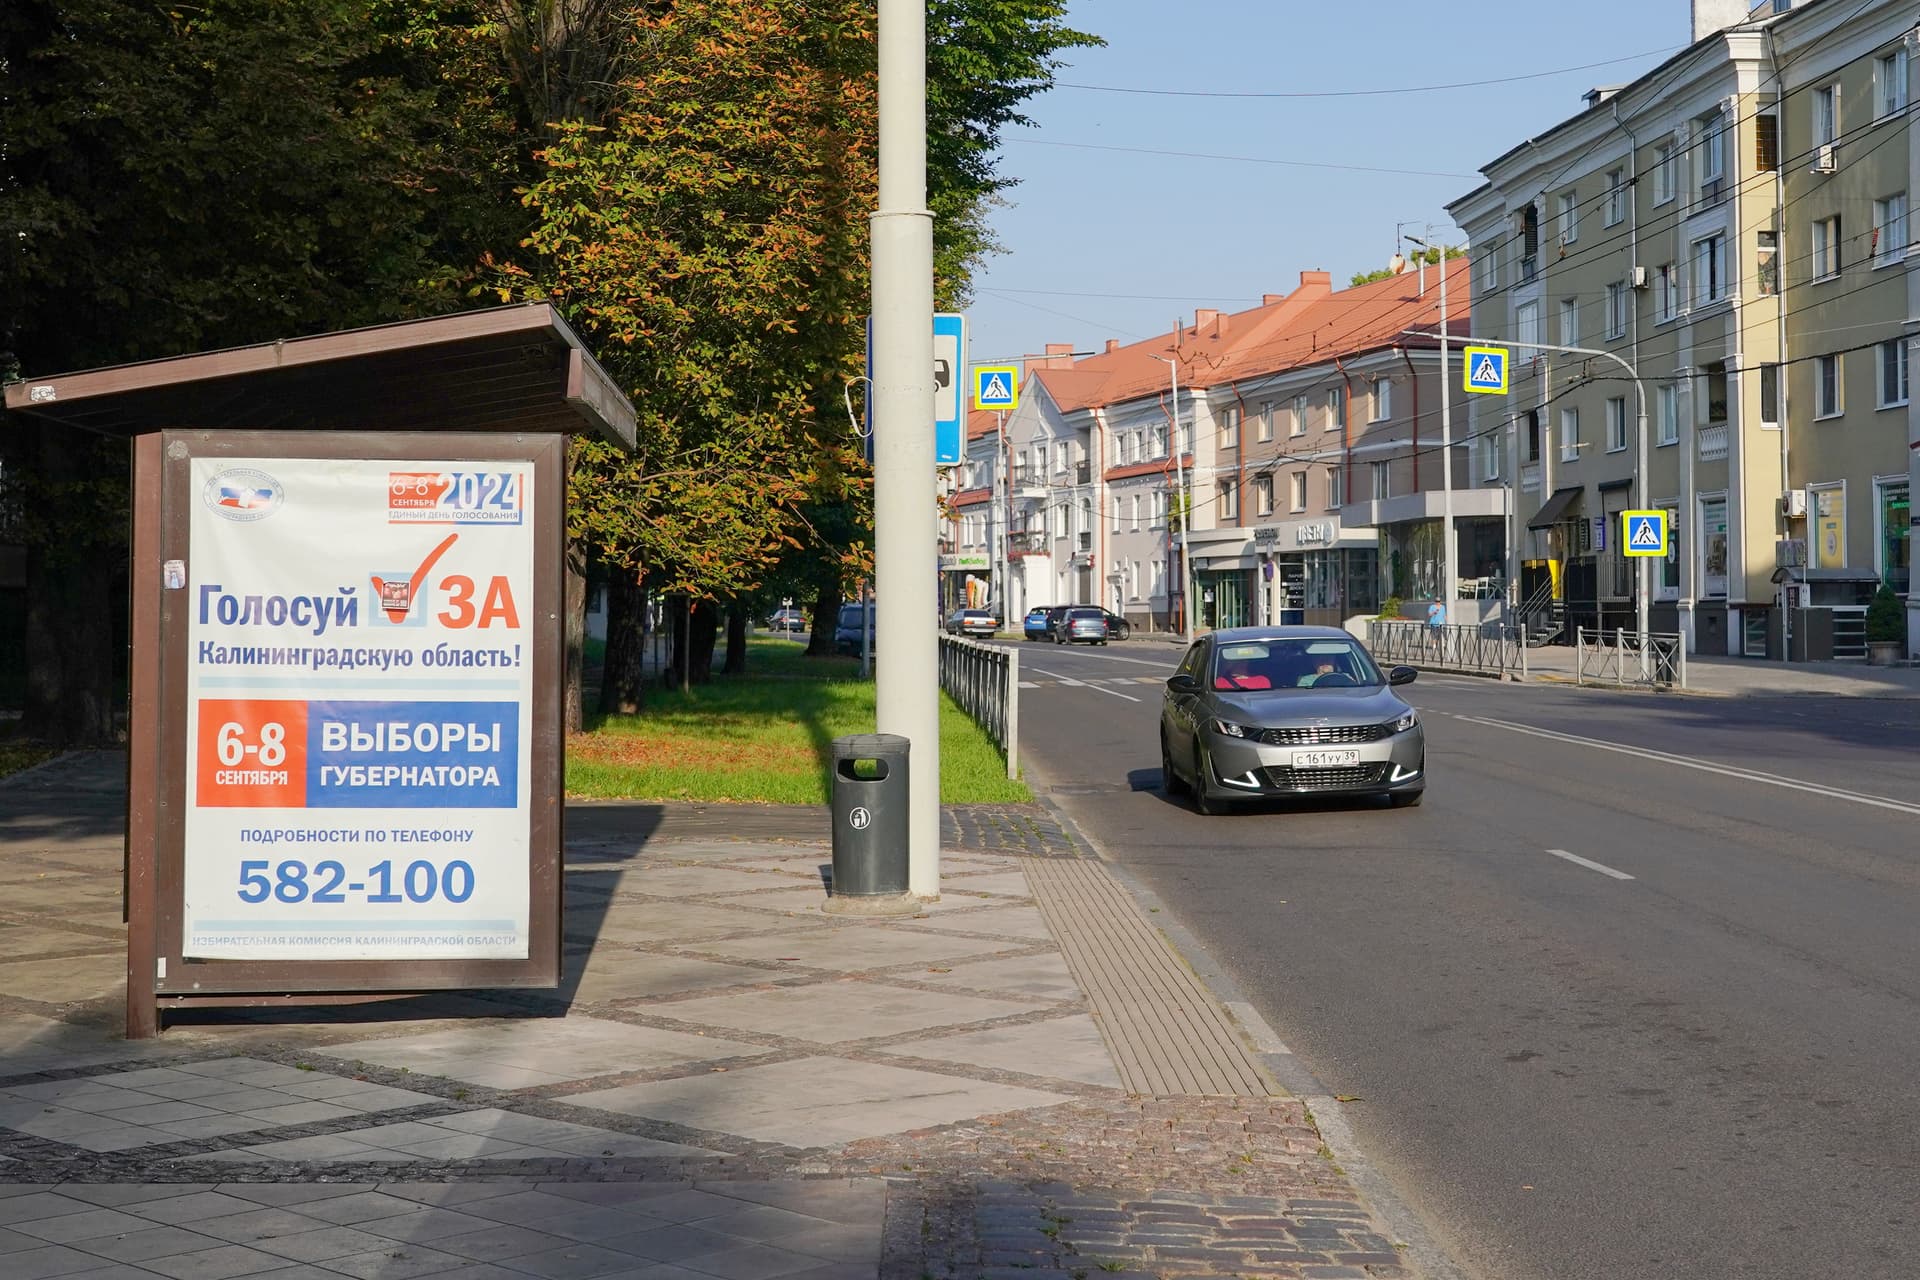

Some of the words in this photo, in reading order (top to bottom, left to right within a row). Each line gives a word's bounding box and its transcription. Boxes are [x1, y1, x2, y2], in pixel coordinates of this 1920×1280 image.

[392, 498, 435, 507] СЕНТЯБРЯ
[436, 473, 518, 509] 2024
[428, 511, 450, 520] ДЕНЬ
[452, 511, 518, 520] ГОЛОСОВАНИЯ
[199, 584, 358, 636] Голосуй
[437, 575, 521, 630] ЗА
[198, 641, 414, 671] Калининградскую
[422, 643, 521, 669] область!
[216, 721, 286, 767] 6-8
[321, 721, 501, 753] ВЫБОРЫ
[215, 769, 289, 786] СЕНТЯБРЯ
[319, 765, 501, 788] ГУБЕРНАТОРА
[240, 828, 360, 845] ПОДРОБНОСТИ
[365, 829, 386, 843] ПО
[390, 829, 475, 844] ТЕЛЕФОНУ
[237, 859, 476, 904] 582-100
[192, 936, 286, 946] ИЗБИРАТЕЛЬНАЯ
[288, 936, 352, 946] КОМИССИЯ
[355, 936, 464, 946] КАЛИНИНГРАДСКОЙ
[466, 936, 517, 946] ОБЛАСТИ
